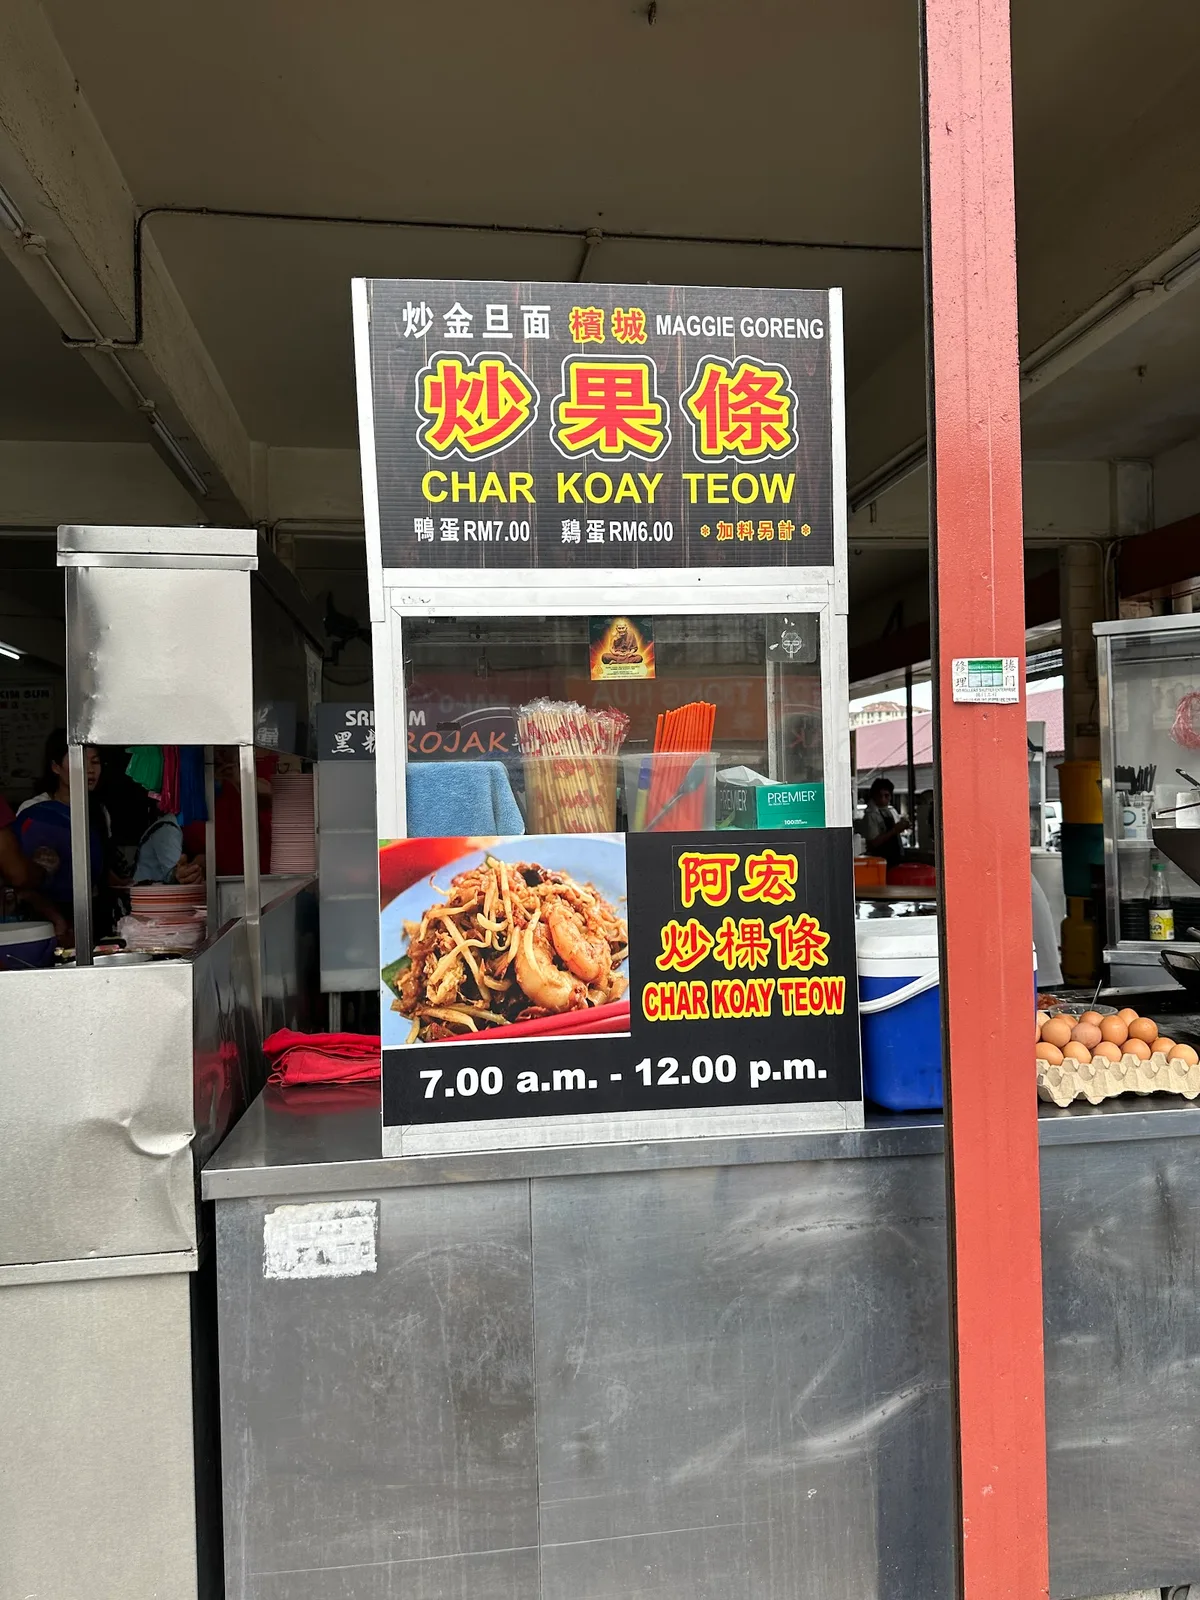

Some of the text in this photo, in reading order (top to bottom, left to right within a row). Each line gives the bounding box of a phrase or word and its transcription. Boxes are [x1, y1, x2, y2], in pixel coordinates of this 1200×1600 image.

[402, 302, 551, 339] 炒金旦面
[569, 306, 648, 345] 檳城
[656, 314, 824, 340] MAGGIE GORENG
[422, 358, 796, 457] 炒果條
[421, 470, 795, 505] CHAR KOAY TEOW
[463, 520, 530, 542] RM7.00
[609, 521, 674, 543] RM6.00
[716, 519, 796, 541] 加料另計
[768, 790, 815, 804] PREMIER
[678, 850, 798, 908] 阿宏
[642, 976, 846, 1022] CHAR KOAY TEOW
[420, 1066, 503, 1099] 7.00
[516, 1066, 598, 1093] a.m.
[634, 1054, 737, 1086] 12.00
[750, 1056, 828, 1088] p.m.
